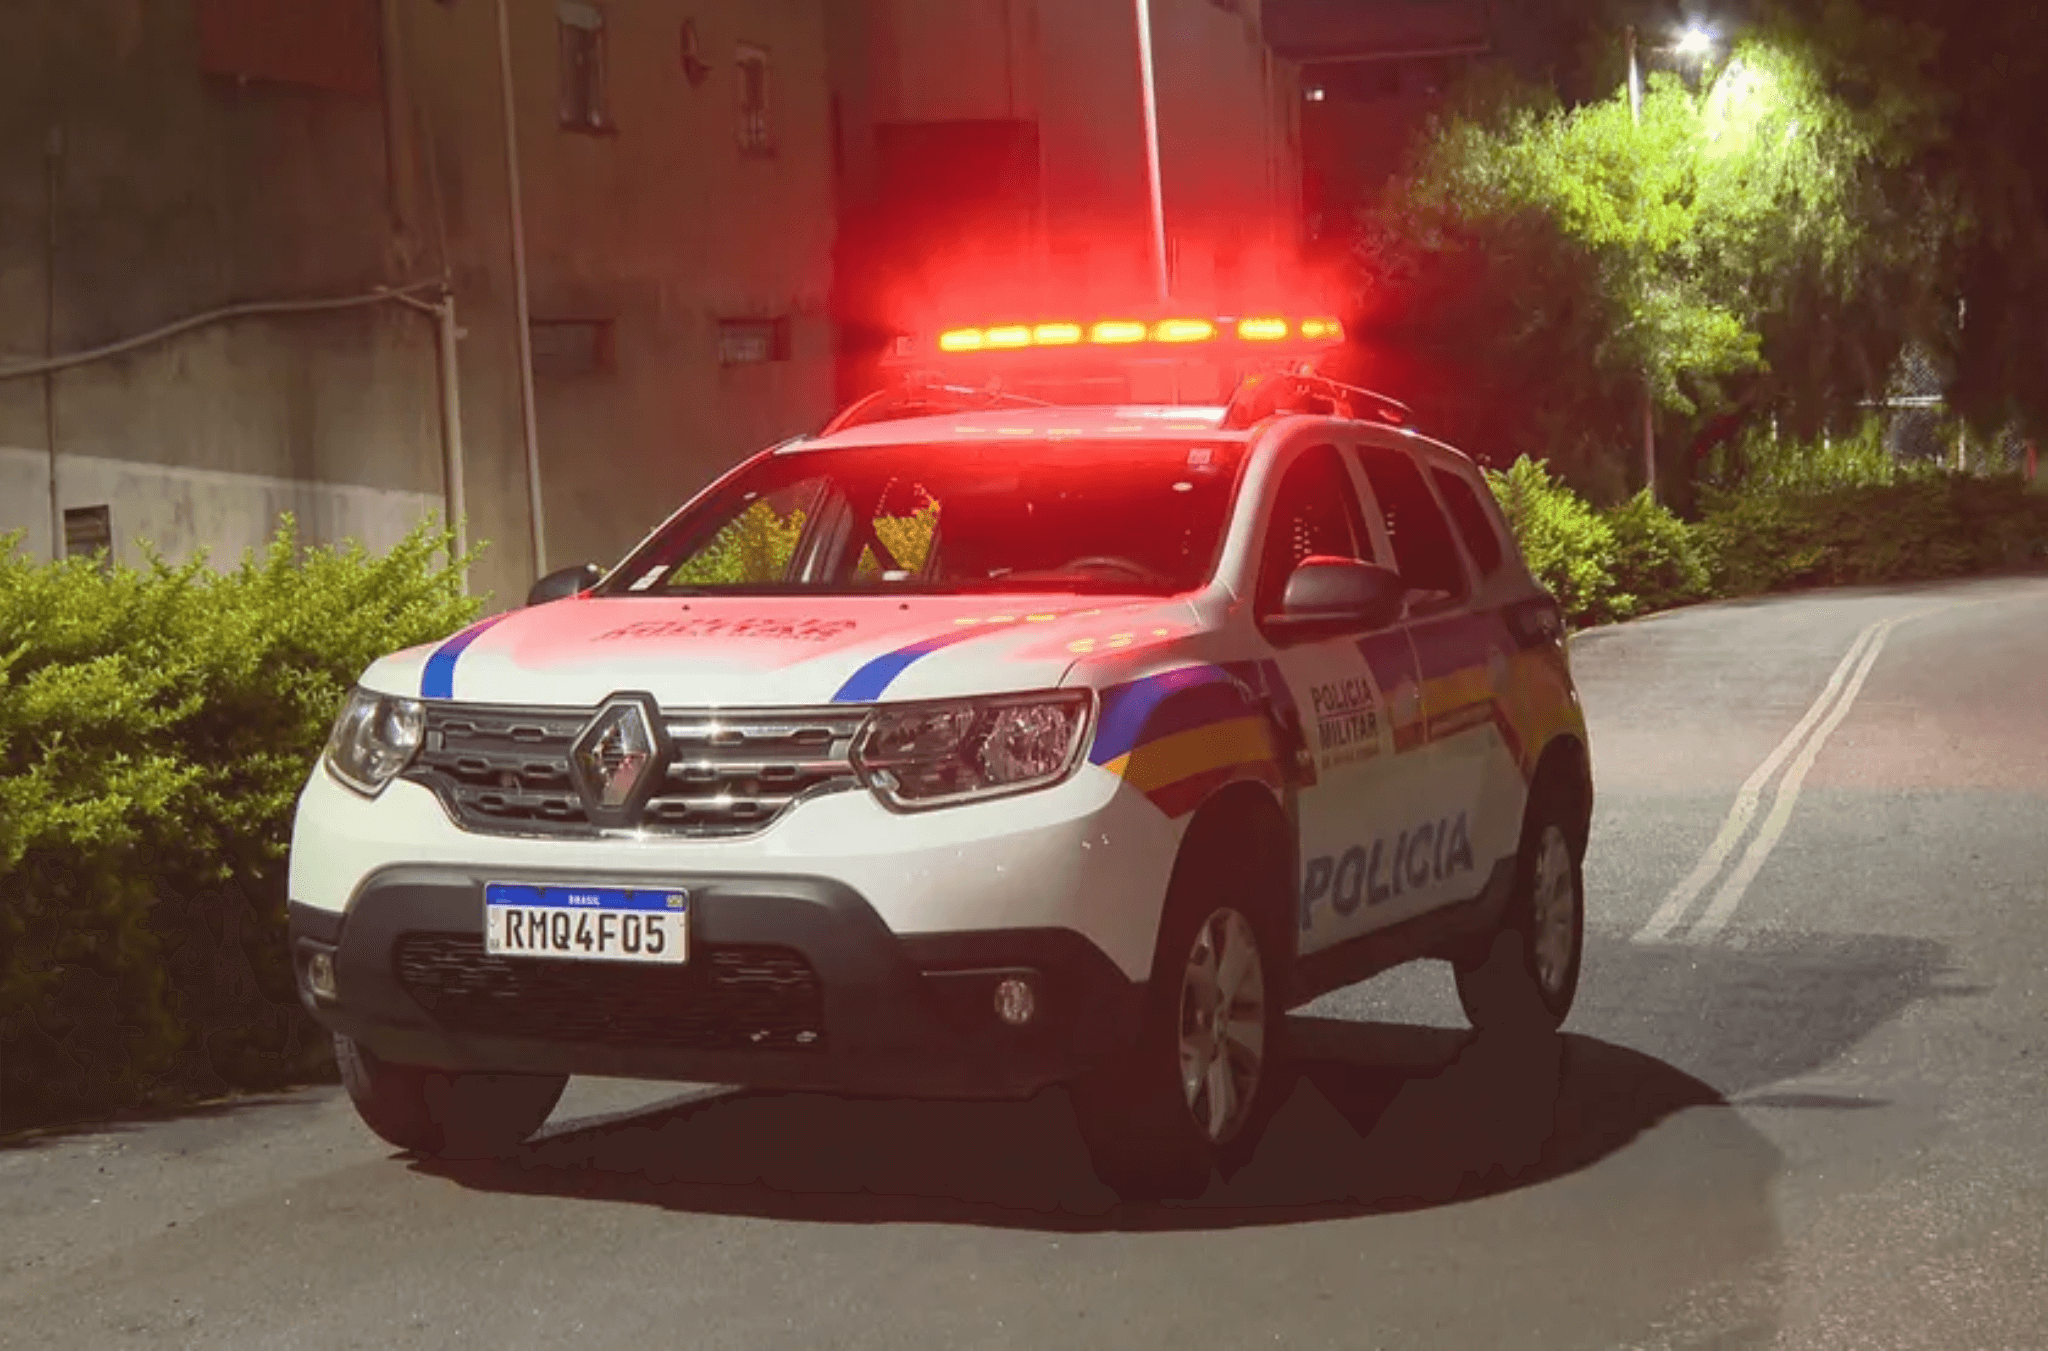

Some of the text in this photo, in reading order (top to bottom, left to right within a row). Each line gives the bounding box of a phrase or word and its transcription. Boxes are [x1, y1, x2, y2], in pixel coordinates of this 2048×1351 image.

[1318, 711, 1379, 751] MILITAR
[1301, 811, 1474, 932] POLICIA
[506, 909, 664, 954] RMQ4F05
